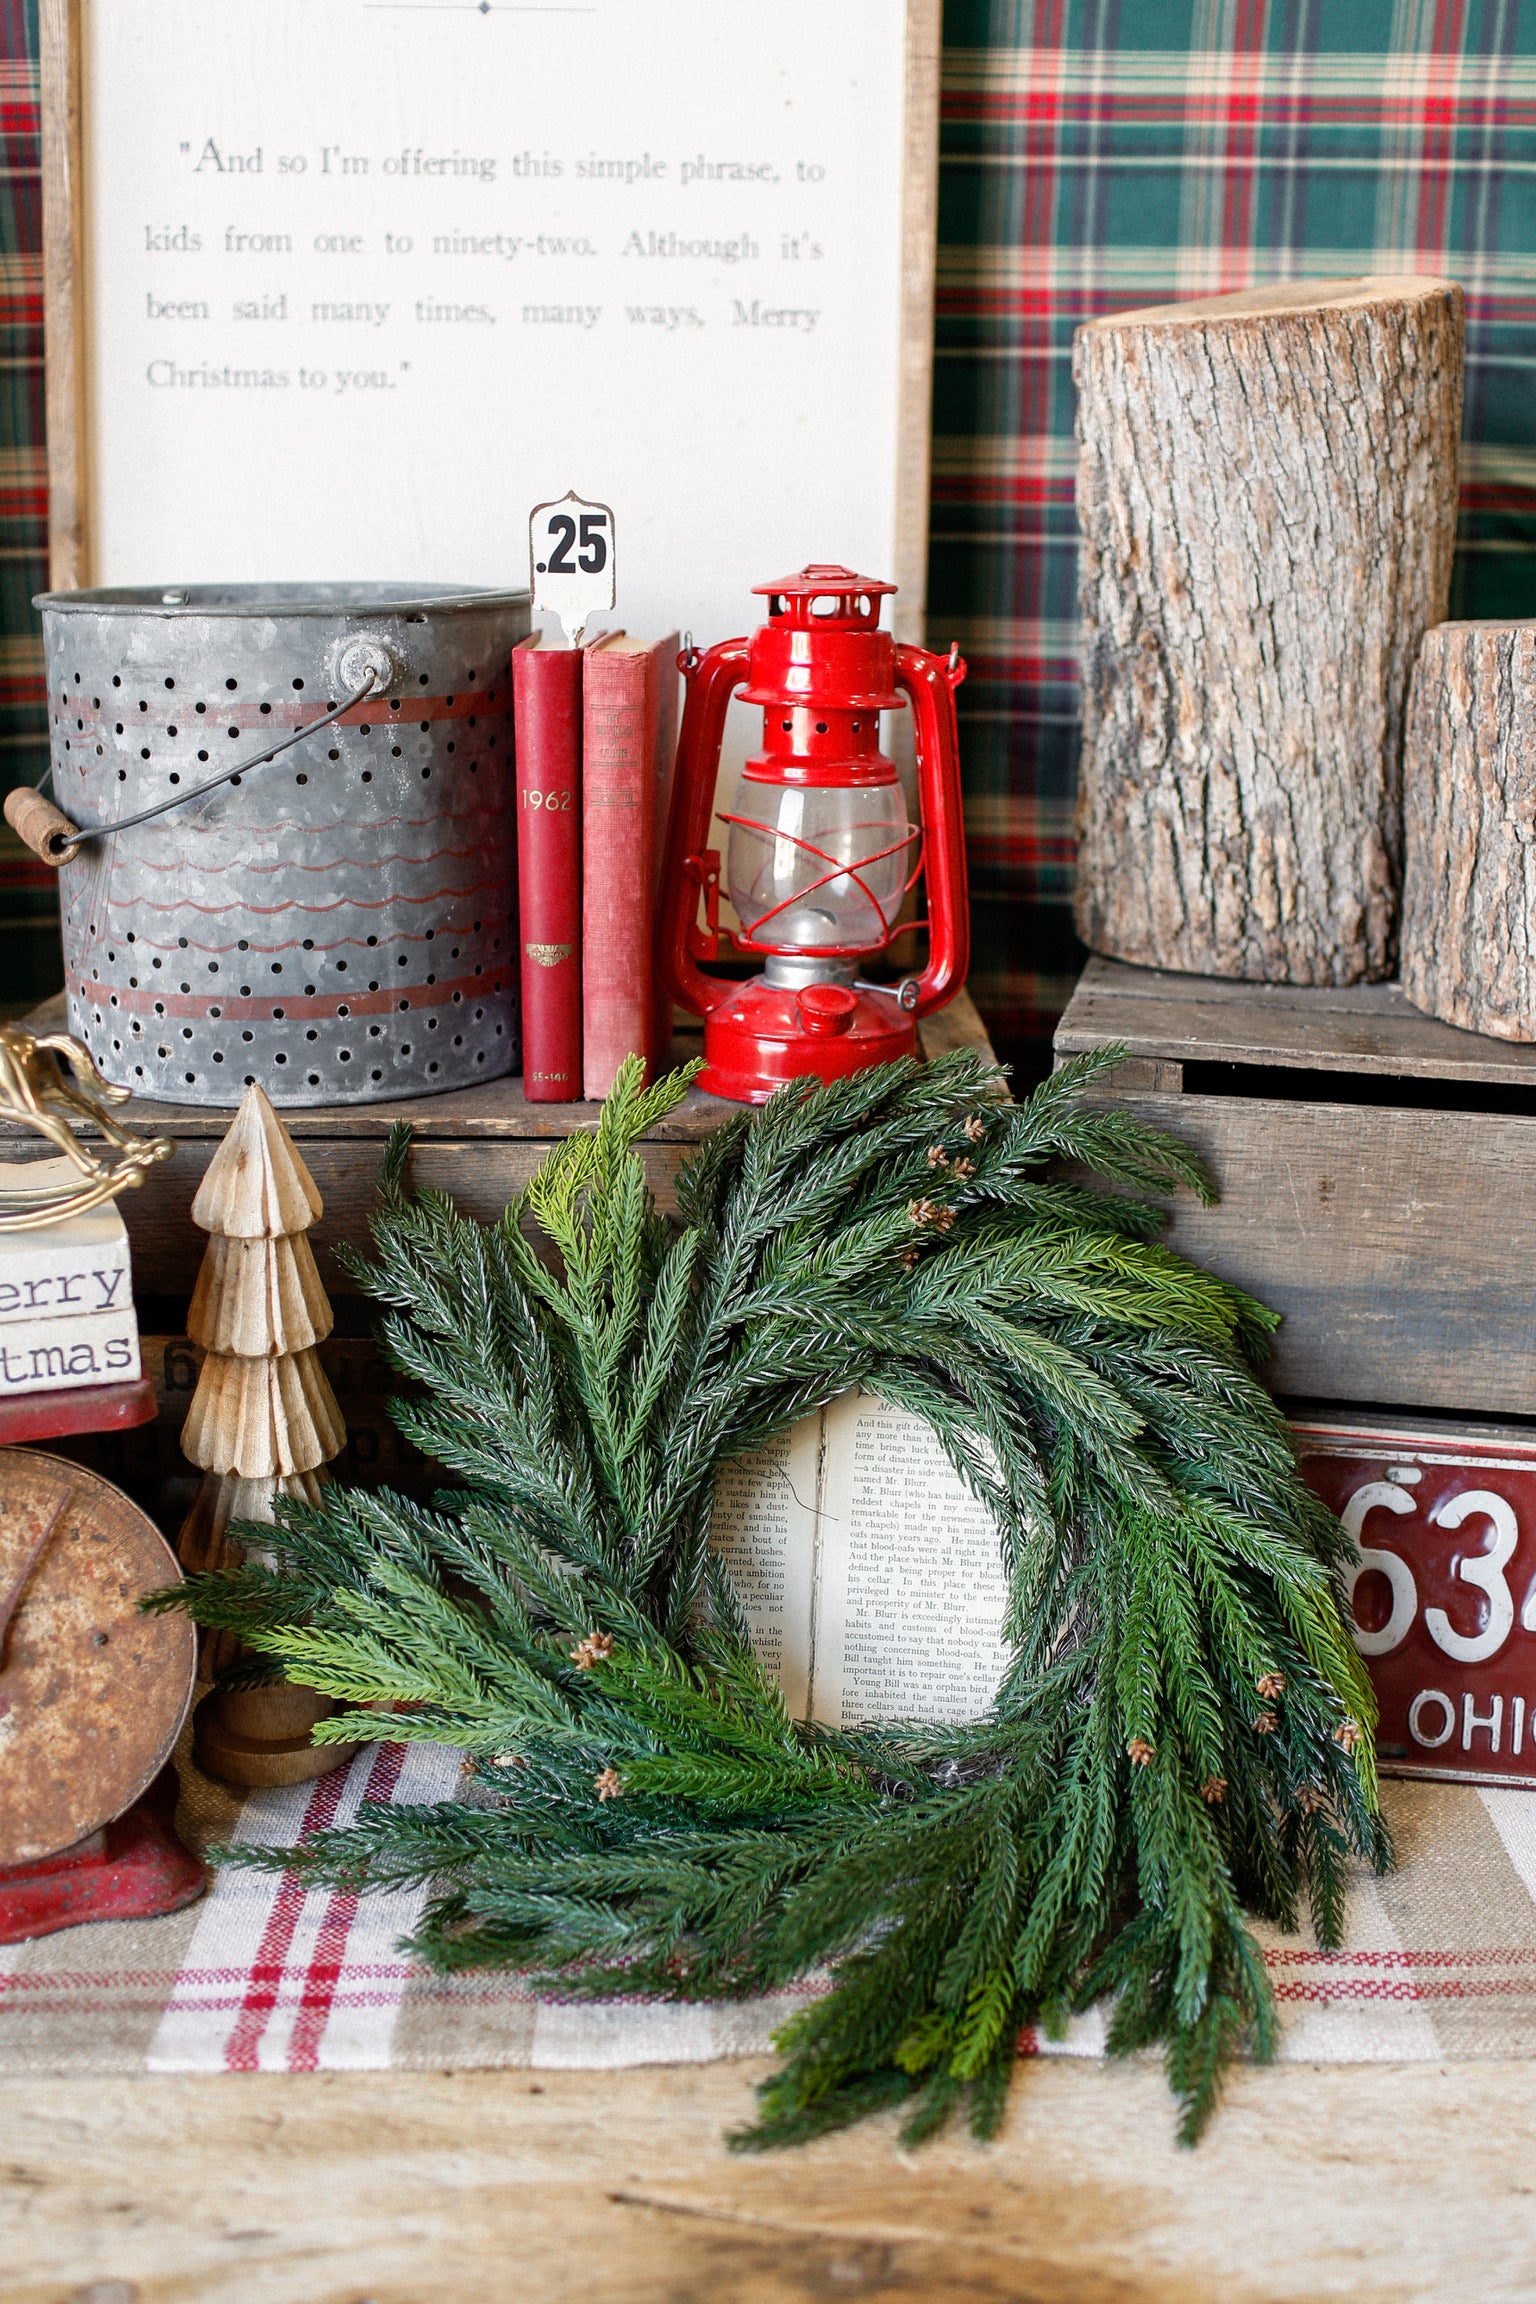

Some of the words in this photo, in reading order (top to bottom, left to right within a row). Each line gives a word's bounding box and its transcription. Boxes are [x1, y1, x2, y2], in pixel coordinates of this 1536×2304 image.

[178, 136, 264, 175] "And
[277, 155, 308, 174] so
[320, 144, 370, 175] I'm
[381, 147, 497, 183] offering
[511, 150, 564, 178] this
[576, 151, 667, 185] simple
[679, 153, 781, 186] phrase,
[795, 160, 826, 183] to
[144, 224, 203, 253] kids
[223, 224, 293, 253] from
[313, 234, 364, 254] one
[384, 232, 414, 254] to
[432, 228, 597, 261] ninety-two.
[622, 230, 759, 265] Although
[781, 231, 823, 260] it's
[145, 291, 210, 320] been
[233, 293, 288, 321] said
[311, 302, 391, 328] many
[414, 296, 497, 325] times,
[522, 305, 602, 330] many
[625, 306, 706, 331] ways,
[732, 298, 821, 333] Merry
[145, 359, 290, 389] Christmas
[298, 367, 328, 389] to
[335, 360, 411, 395] you."
[536, 514, 607, 574] .25
[522, 789, 572, 811] 1962
[878, 1403, 896, 1412] Mr.
[857, 1418, 875, 1427] And
[877, 1420, 893, 1428] this
[896, 1421, 910, 1431] gift
[913, 1422, 931, 1431] does
[734, 1455, 743, 1463] of
[854, 1451, 874, 1460] form
[877, 1453, 886, 1461] of
[889, 1454, 921, 1464] disaster
[871, 1464, 904, 1474] disaster
[907, 1466, 915, 1474] in
[918, 1467, 935, 1476] side
[725, 1477, 734, 1485] of
[748, 1478, 763, 1486] few
[767, 1479, 790, 1490] apple
[853, 1474, 881, 1483] named
[885, 1476, 899, 1484] Mr.
[904, 1477, 928, 1486] Blurr.
[726, 1488, 756, 1497] sustain
[760, 1490, 776, 1498] him
[781, 1491, 789, 1499] in
[862, 1485, 876, 1494] Mr.
[880, 1486, 902, 1496] Blurr
[905, 1488, 925, 1499] (who
[928, 1490, 942, 1498] has
[945, 1491, 965, 1500] built
[729, 1500, 749, 1508] likes
[766, 1502, 788, 1510] dust-
[736, 1511, 745, 1519] of
[749, 1512, 787, 1524] sunshine,
[743, 1523, 760, 1531] and
[763, 1524, 771, 1532] in
[775, 1525, 787, 1533] his
[752, 1535, 772, 1543] bout
[778, 1536, 787, 1544] of
[721, 1544, 752, 1554] currant
[755, 1546, 785, 1556] bushes.
[759, 1558, 785, 1567] demo-
[746, 1569, 784, 1579] ambition
[1340, 1481, 1536, 1663] 63
[734, 1579, 754, 1590] who,
[758, 1580, 770, 1589] for
[750, 1591, 784, 1602] peculiar
[742, 1602, 762, 1611] does
[769, 1604, 783, 1612] not
[846, 1595, 863, 1604] and
[866, 1597, 910, 1609] prosperity
[913, 1600, 921, 1608] of
[925, 1601, 939, 1610] Mr.
[943, 1603, 968, 1612] Blurr.
[856, 1608, 870, 1616] Mr.
[875, 1609, 898, 1618] Blurr
[901, 1611, 909, 1619] is
[912, 1612, 962, 1625] exceedingly
[756, 1626, 764, 1634] in
[769, 1626, 783, 1635] the
[845, 1618, 872, 1627] habits
[879, 1621, 895, 1629] and
[902, 1622, 937, 1632] customs
[943, 1625, 952, 1634] of
[752, 1637, 782, 1646] whistle
[844, 1630, 894, 1641] accustomed
[897, 1634, 907, 1642] to
[909, 1637, 924, 1645] say
[927, 1636, 944, 1645] that
[947, 1638, 979, 1649] nobody
[762, 1651, 781, 1659] very
[844, 1641, 877, 1653] nothing
[883, 1644, 930, 1657] concerning
[936, 1648, 982, 1659] blood-oafs.
[992, 1652, 1009, 1661] But
[844, 1653, 859, 1661] Bill
[864, 1654, 892, 1666] taught
[896, 1657, 913, 1665] him
[917, 1658, 963, 1671] something.
[974, 1663, 987, 1671] He
[843, 1665, 886, 1677] important
[889, 1668, 896, 1676] it
[898, 1669, 906, 1677] is
[909, 1670, 918, 1678] to
[920, 1671, 945, 1682] repair
[948, 1672, 971, 1681] one's
[853, 1676, 881, 1688] Young
[884, 1679, 900, 1687] Bill
[936, 1682, 966, 1694] orphan
[970, 1685, 990, 1694] bird.
[842, 1687, 859, 1696] fore
[865, 1689, 906, 1699] inhabited
[913, 1692, 927, 1701] the
[933, 1694, 967, 1704] smallest
[974, 1697, 982, 1705] of
[841, 1698, 864, 1708] three
[867, 1700, 895, 1710] cellars
[898, 1703, 914, 1711] and
[918, 1704, 934, 1713] had
[947, 1708, 966, 1717] cage
[970, 1708, 979, 1716] to
[841, 1710, 866, 1721] Blurr,
[1409, 1688, 1536, 1755] OHI
